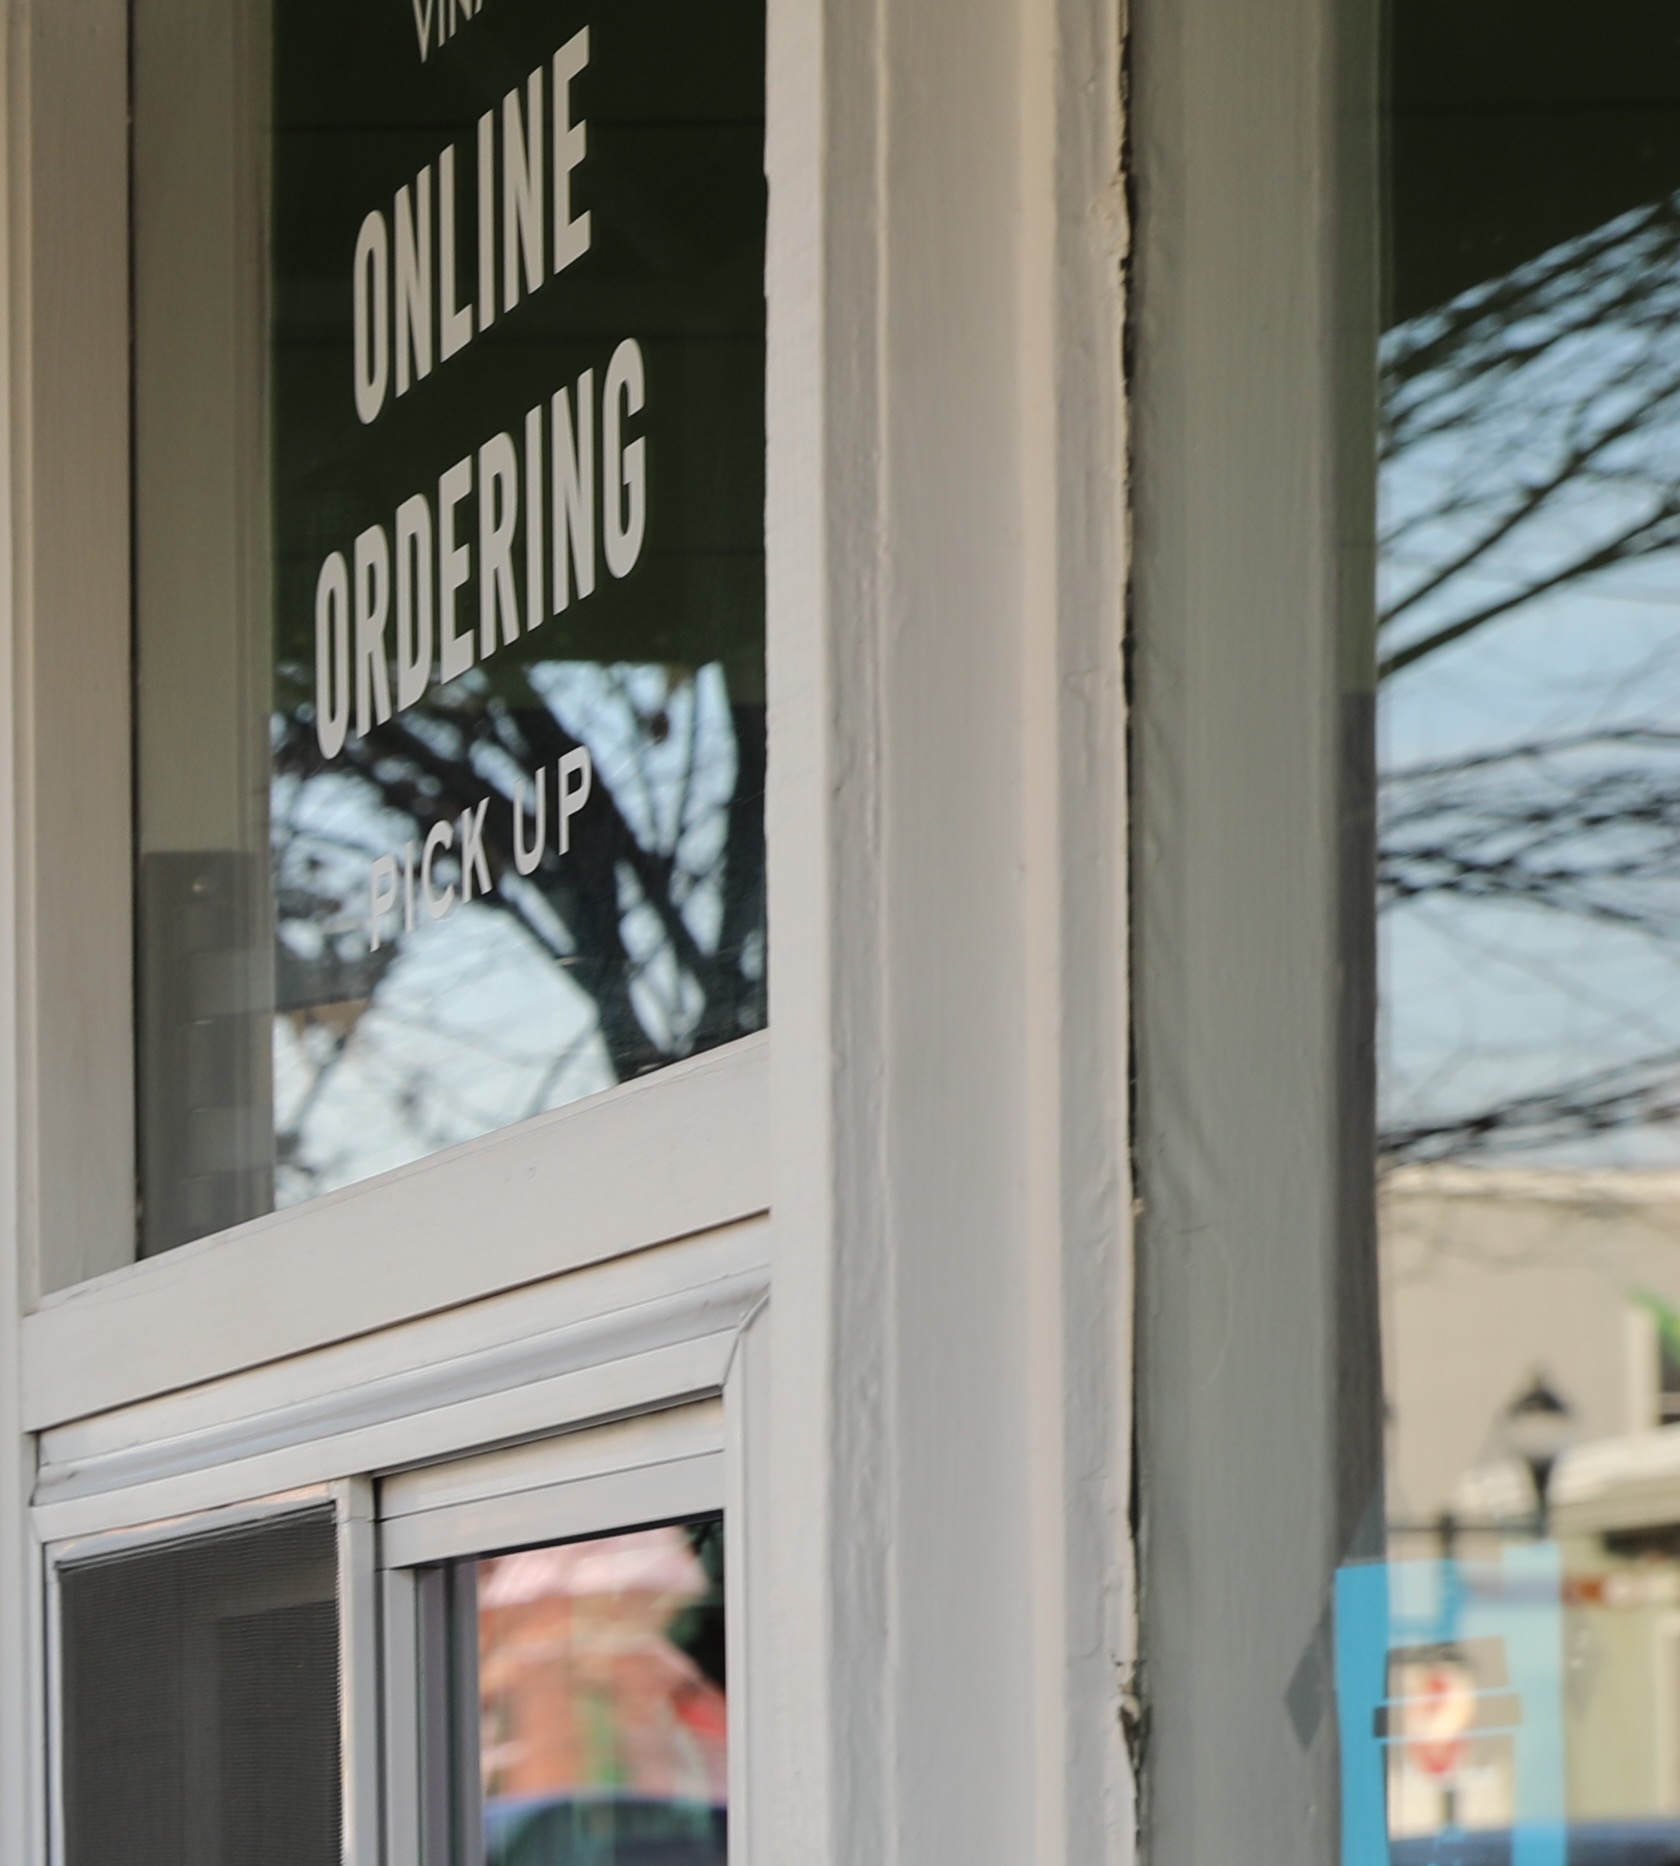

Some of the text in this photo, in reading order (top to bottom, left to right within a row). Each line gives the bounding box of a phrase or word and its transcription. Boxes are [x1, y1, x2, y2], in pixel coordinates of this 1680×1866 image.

[353, 25, 592, 425] ONLINE
[315, 337, 646, 760] ORDERING
[370, 745, 592, 952] PICK UP
